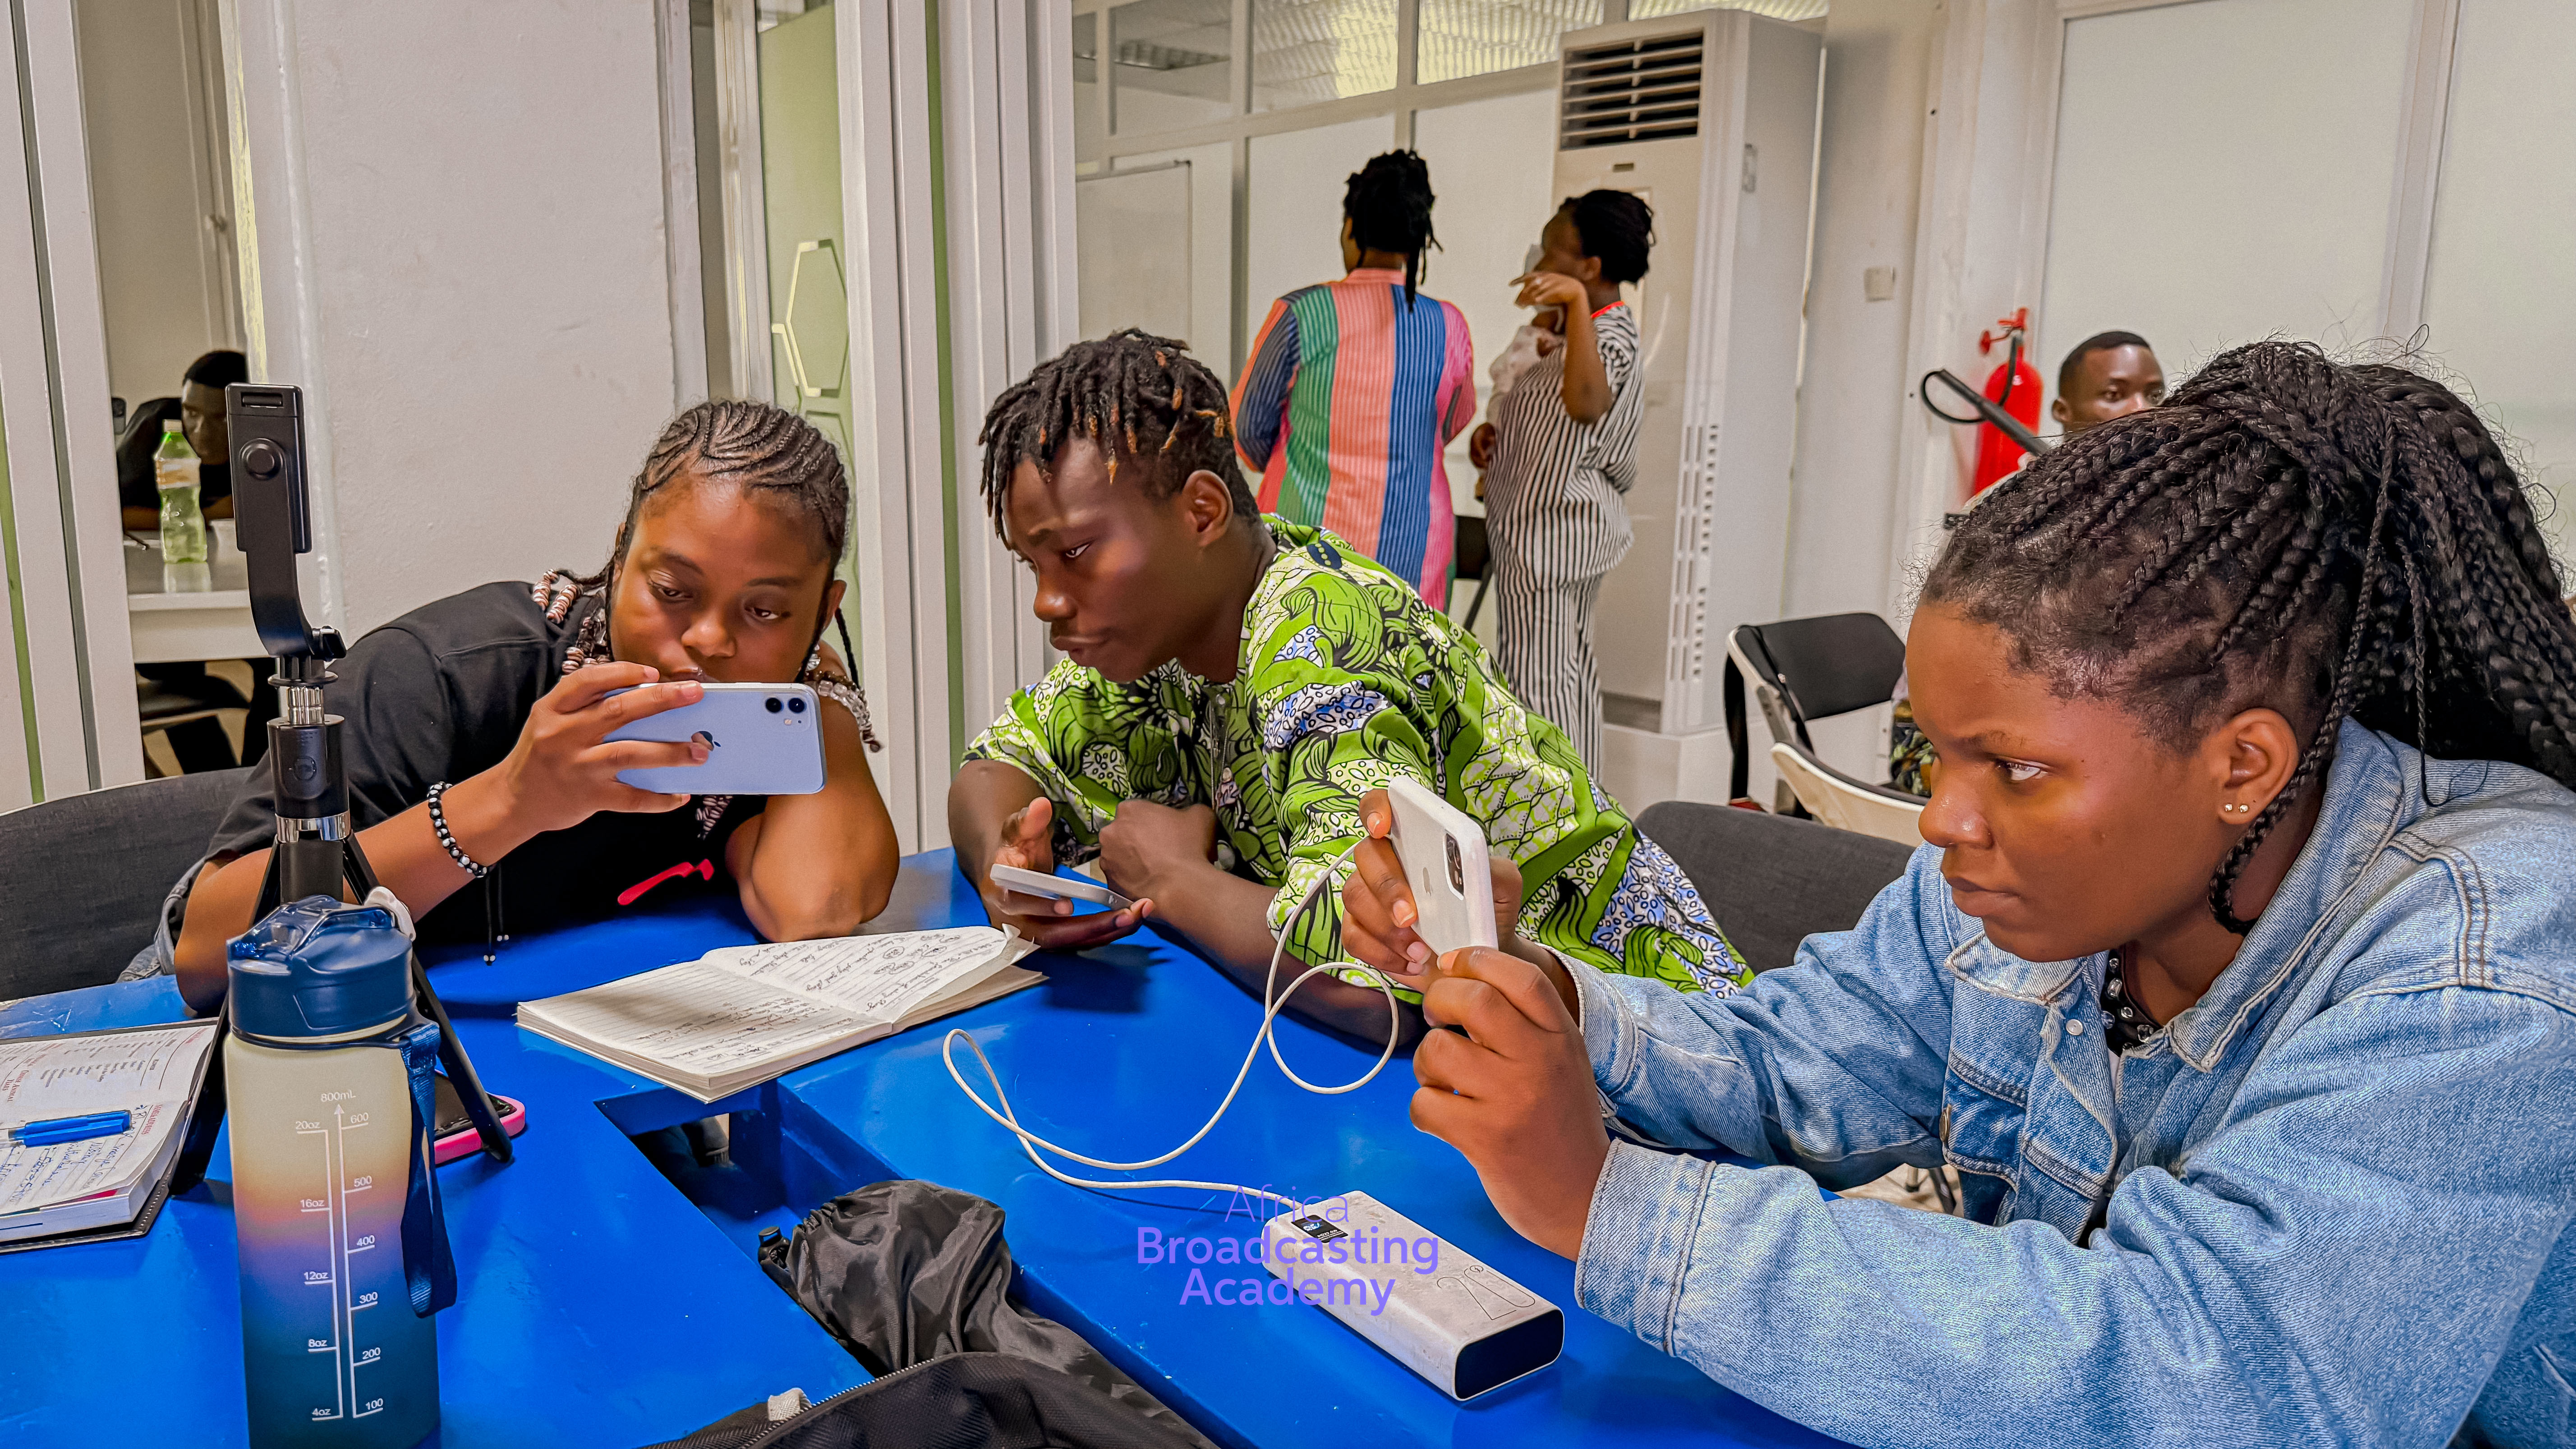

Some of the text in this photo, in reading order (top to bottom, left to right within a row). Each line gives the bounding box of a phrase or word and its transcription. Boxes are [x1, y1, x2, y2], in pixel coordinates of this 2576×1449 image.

[321, 1090, 356, 1102] 800mL
[350, 1112, 369, 1123] 600
[295, 1121, 321, 1129] 20oz
[354, 1175, 373, 1187] 500
[300, 1199, 325, 1208] 16oz
[356, 1235, 375, 1246] 400
[304, 1271, 329, 1280] 12oz
[359, 1292, 378, 1304] 300
[308, 1339, 327, 1347] 8oz
[362, 1347, 381, 1360] 200
[365, 1398, 383, 1410] 100
[312, 1408, 331, 1416] 4oz
